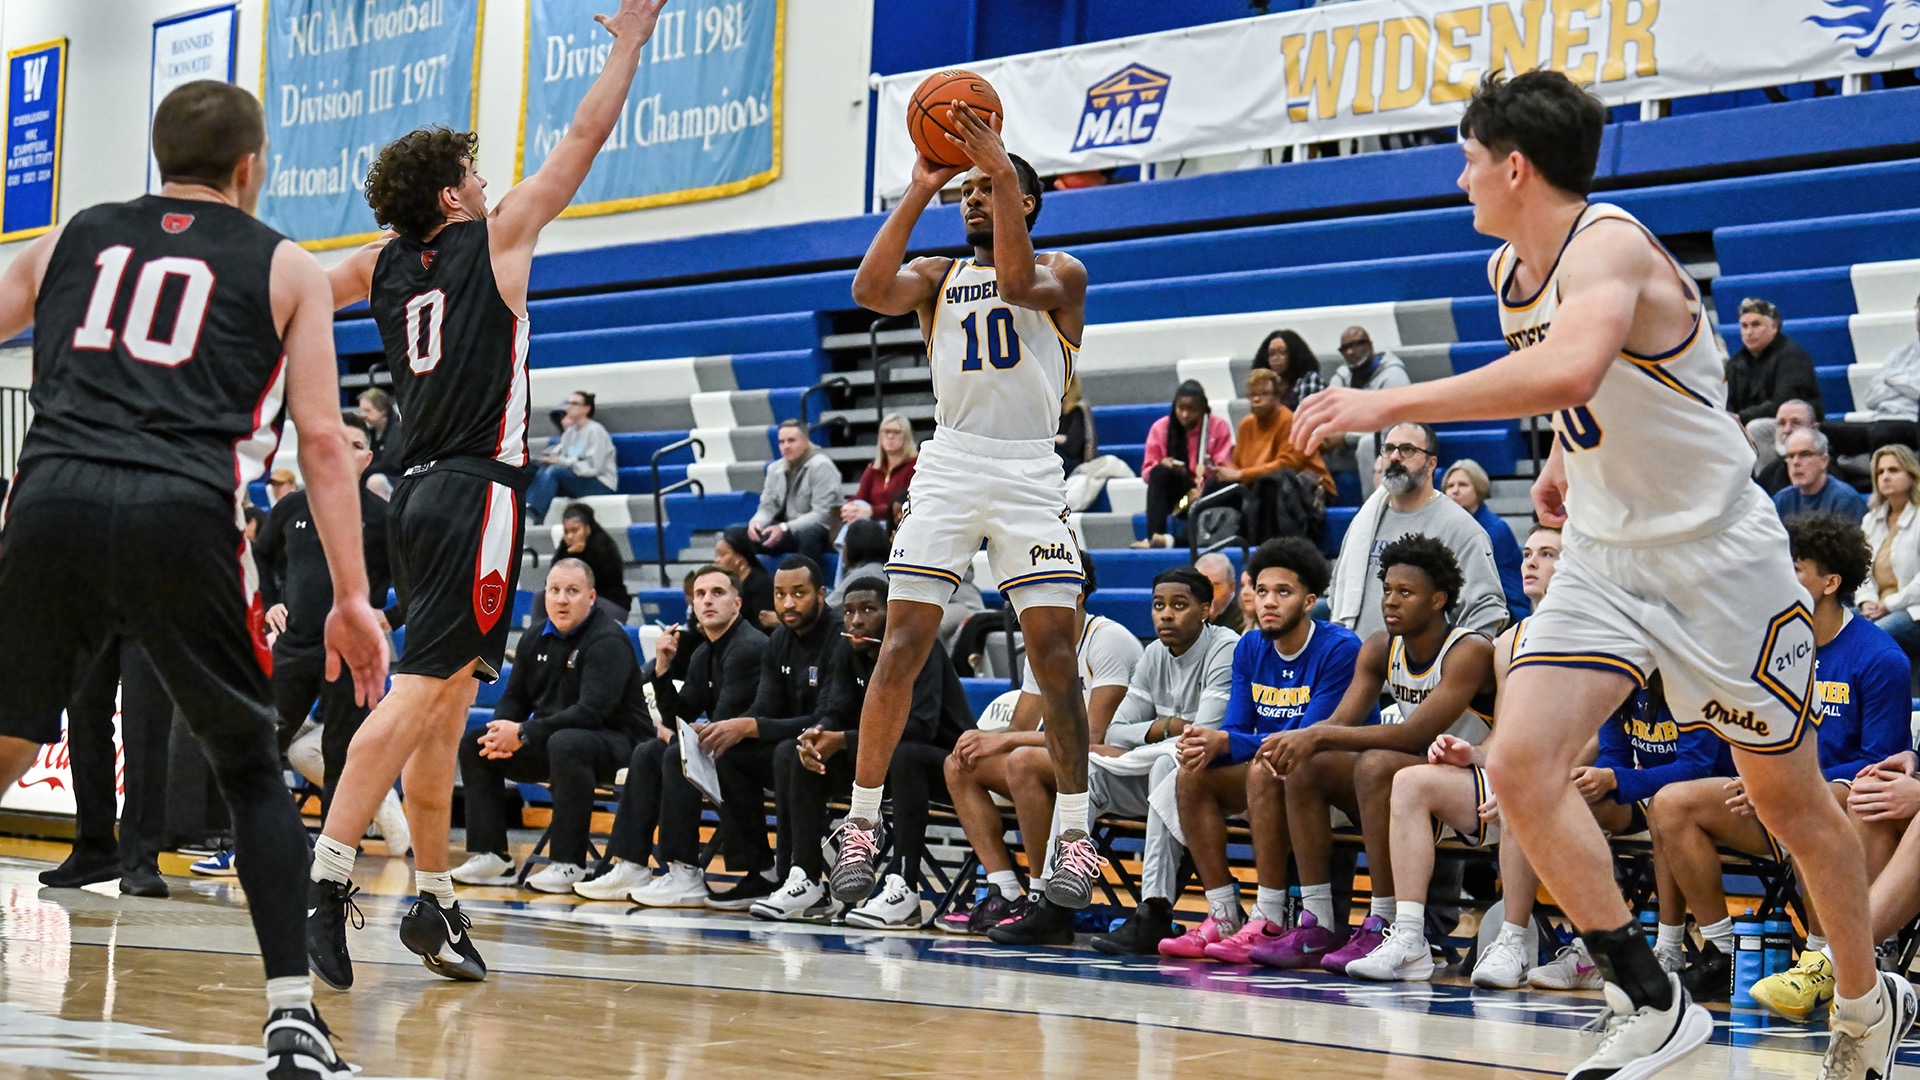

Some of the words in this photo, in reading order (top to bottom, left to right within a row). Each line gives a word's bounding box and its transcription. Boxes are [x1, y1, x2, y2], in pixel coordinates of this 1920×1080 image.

[287, 3, 359, 59] NCAA
[362, 0, 443, 44] Football
[652, 10, 686, 65] III
[692, 1, 746, 57] 1981
[1281, 0, 1659, 123] WIDENER
[281, 79, 363, 128] Division
[368, 65, 396, 115] III
[401, 53, 447, 107] 1977
[634, 86, 770, 151] Champions
[1076, 102, 1161, 148] MAC
[71, 243, 218, 369] 10
[405, 287, 448, 377] 0
[960, 306, 1022, 372] 10
[1028, 543, 1074, 567] Pride
[1775, 640, 1812, 672] 21/CL
